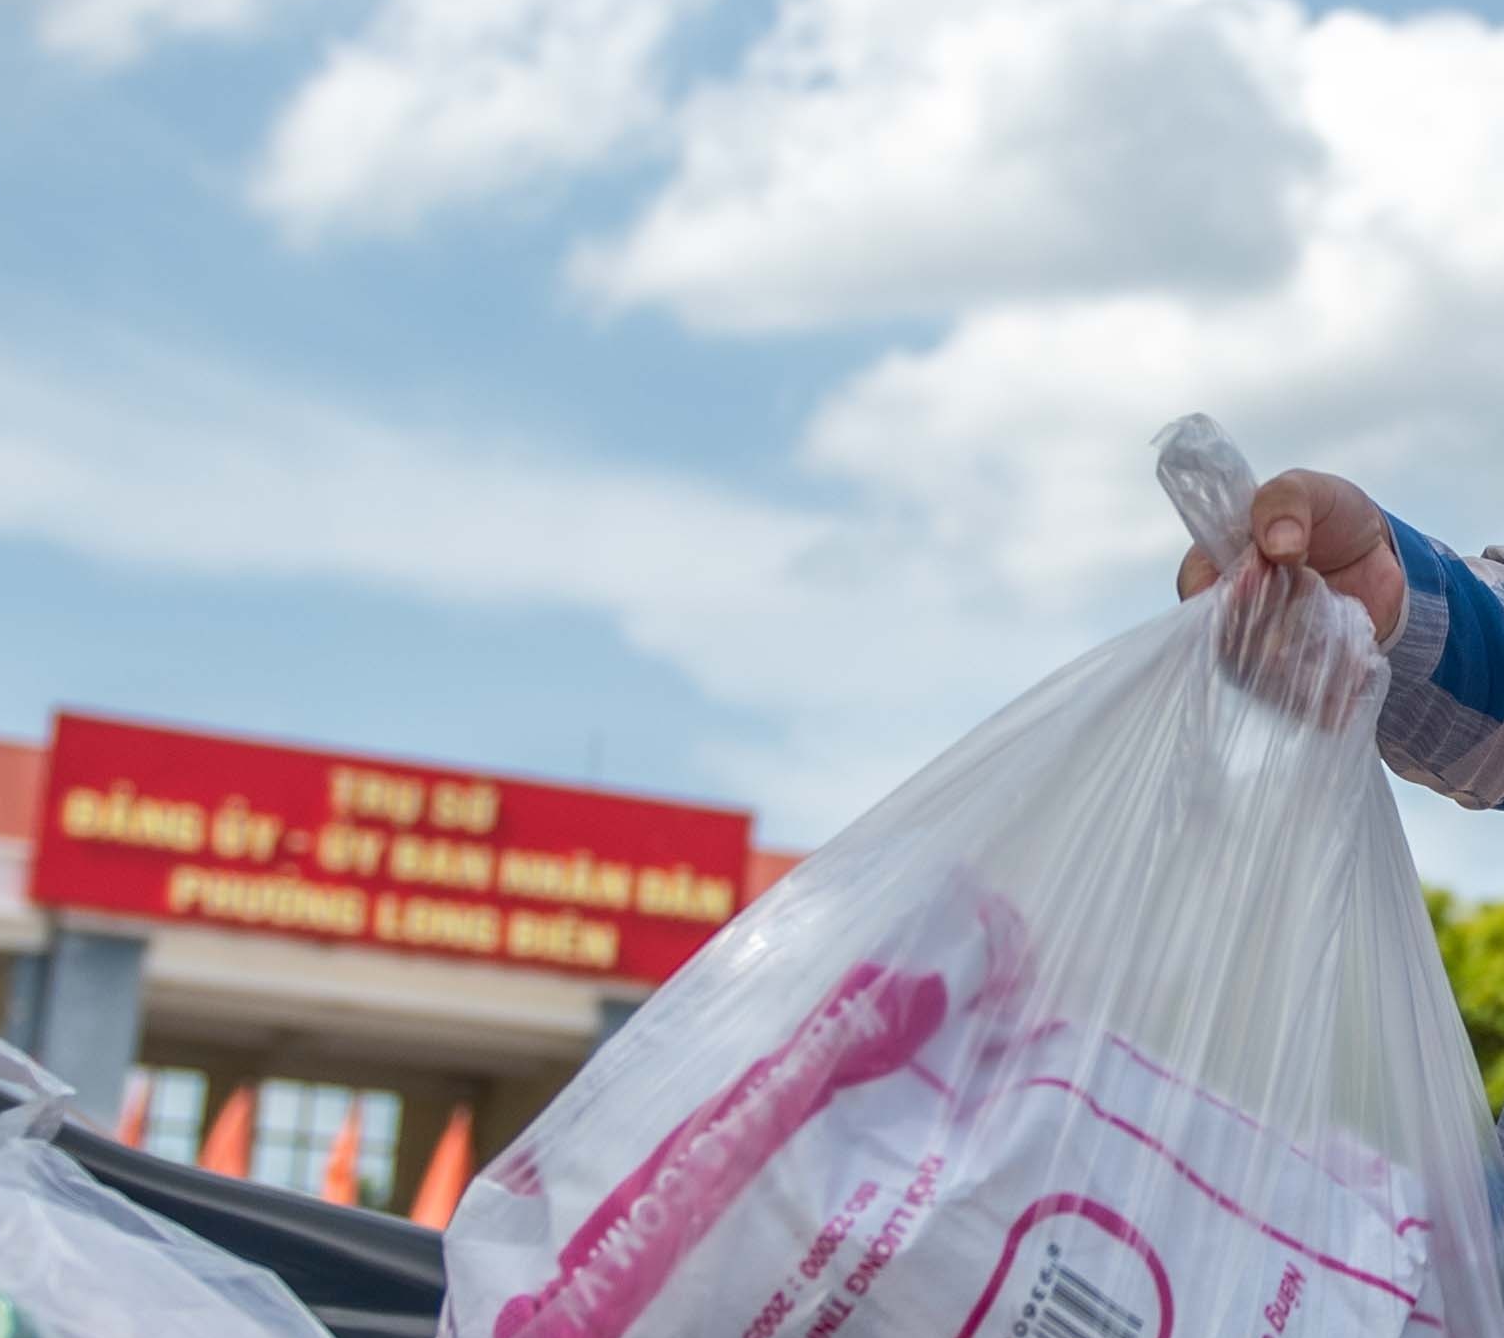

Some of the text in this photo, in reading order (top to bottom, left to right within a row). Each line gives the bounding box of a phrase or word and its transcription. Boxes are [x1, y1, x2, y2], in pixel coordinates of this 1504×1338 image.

[390, 831, 495, 892] BAN
[498, 847, 633, 910] NHÂN
[636, 860, 734, 924] DÂN
[373, 890, 499, 954] LONG
